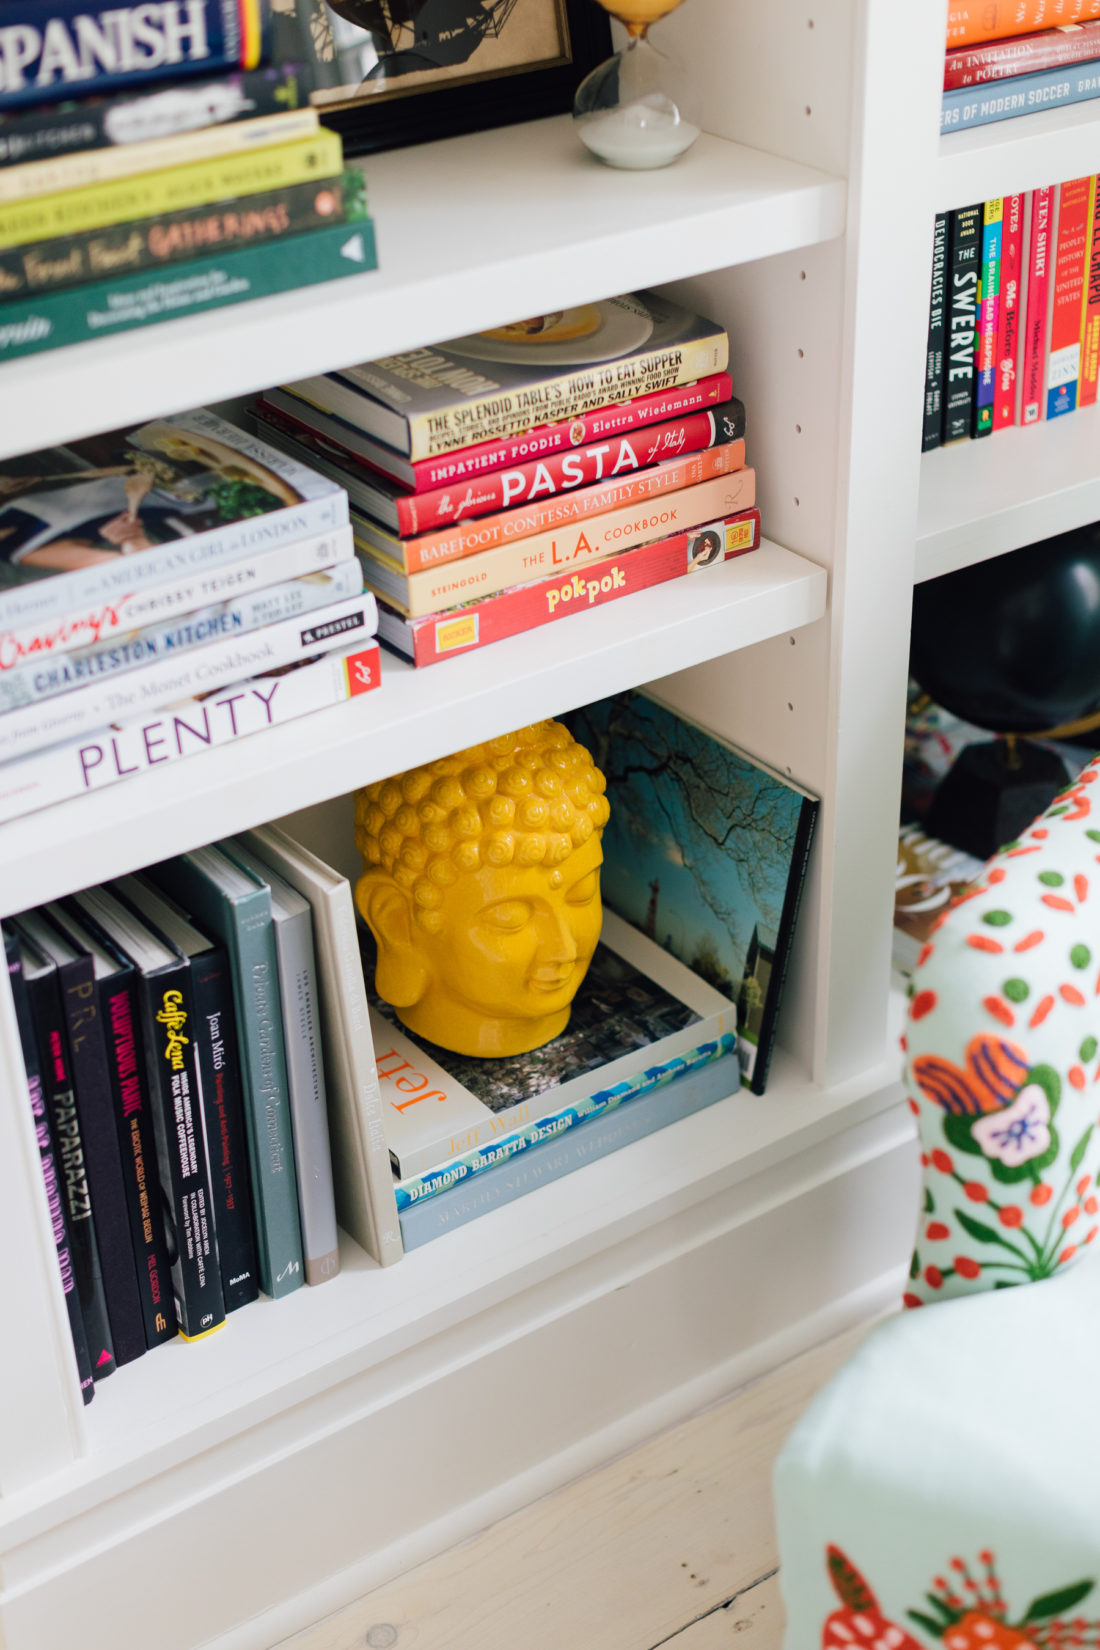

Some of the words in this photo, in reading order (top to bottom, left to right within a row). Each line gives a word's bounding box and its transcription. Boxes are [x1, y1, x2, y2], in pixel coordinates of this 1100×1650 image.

[0, 0, 210, 92] PANISH
[967, 44, 1034, 67] INVITATION
[976, 63, 1018, 81] POETRY
[963, 104, 978, 121] OF
[981, 93, 1025, 117] MODERN
[1028, 83, 1070, 105] SOCCER
[1039, 197, 1048, 229] TEN
[931, 220, 946, 305] DEMOCRACIES
[959, 247, 976, 261] THE
[989, 237, 997, 258] THE
[1036, 232, 1046, 277] SHIRT
[986, 260, 996, 321] BRAINDEAD
[931, 308, 942, 330] DIE
[949, 272, 977, 382] SWERVE
[982, 322, 993, 385] MEGAPHONE
[427, 415, 449, 433] THE
[453, 400, 512, 427] SPLENDID
[516, 382, 562, 404] TABLE'S
[568, 373, 595, 395] HOW
[599, 371, 614, 386] TO
[616, 364, 637, 382] EAT
[640, 350, 683, 375] SUPPER
[598, 383, 619, 397] AWARD
[620, 376, 645, 391] WINNING
[646, 370, 662, 382] FOOD
[663, 366, 680, 378] SHOW
[428, 435, 468, 454] LYNNE
[471, 417, 530, 441] ROSSETTO
[533, 403, 579, 424] KASPER
[581, 395, 605, 411] AND
[608, 386, 643, 402] SALLY
[644, 375, 679, 391] SWIFT
[430, 450, 507, 482] IMPATIENT
[511, 434, 562, 458] FOODIE
[592, 414, 634, 433] Elettra
[637, 393, 703, 419] Wiedemann
[437, 494, 454, 516] the
[453, 487, 496, 520] glorious
[501, 438, 639, 507] PASTA
[646, 434, 661, 462] of
[661, 427, 686, 453] Italy
[240, 516, 308, 547] LONDON
[419, 526, 500, 563] BAREFOOT
[503, 503, 579, 536] CONTESSA
[583, 484, 634, 512] FAMILY
[637, 470, 679, 494] STYLE
[431, 572, 488, 597] STEINGOLD
[522, 552, 545, 569] THE
[551, 531, 600, 565] L.A.
[603, 509, 678, 542] COOKBOOK
[126, 588, 194, 617] CHRISSY
[201, 567, 257, 594] TEIGEN
[315, 617, 360, 640] PRESTEL
[34, 638, 157, 693] CHARLESTON
[165, 610, 242, 649] KITCHEN
[195, 642, 275, 681] Cookbook
[80, 681, 279, 787] PLENTY
[302, 969, 310, 987] LOS
[206, 1011, 221, 1040] Joan
[305, 992, 313, 1031] ANGELES
[109, 990, 137, 1078] VOLUPTUOUS
[164, 1028, 190, 1071] Lena
[212, 1040, 226, 1070] Miró
[258, 1018, 276, 1078] Gardens
[171, 1074, 181, 1097] FOLK
[180, 1071, 191, 1097] INSIDE
[260, 1079, 280, 1093] of
[309, 1035, 319, 1101] ARCHITECTURE
[120, 1075, 143, 1118] PANIC
[173, 1095, 183, 1123] MUSIC
[182, 1096, 194, 1135] AMERICA'S
[176, 1122, 191, 1179] COFFEEHOUSE
[265, 1096, 283, 1174] Connecticut
[409, 1165, 467, 1201] DIAMOND
[472, 1137, 527, 1171] BARATTA
[530, 1114, 573, 1143] DESIGN
[577, 1100, 607, 1118] William
[608, 1083, 641, 1104] Diamond
[447, 1126, 480, 1156] Jeff
[489, 1104, 530, 1135] Wall
[53, 1089, 92, 1221] PAPARAZZI
[134, 1157, 146, 1183] WORLD
[186, 1133, 198, 1175] LEGENDARY
[150, 1269, 162, 1304] GORDON
[229, 1272, 250, 1286] MoMA
